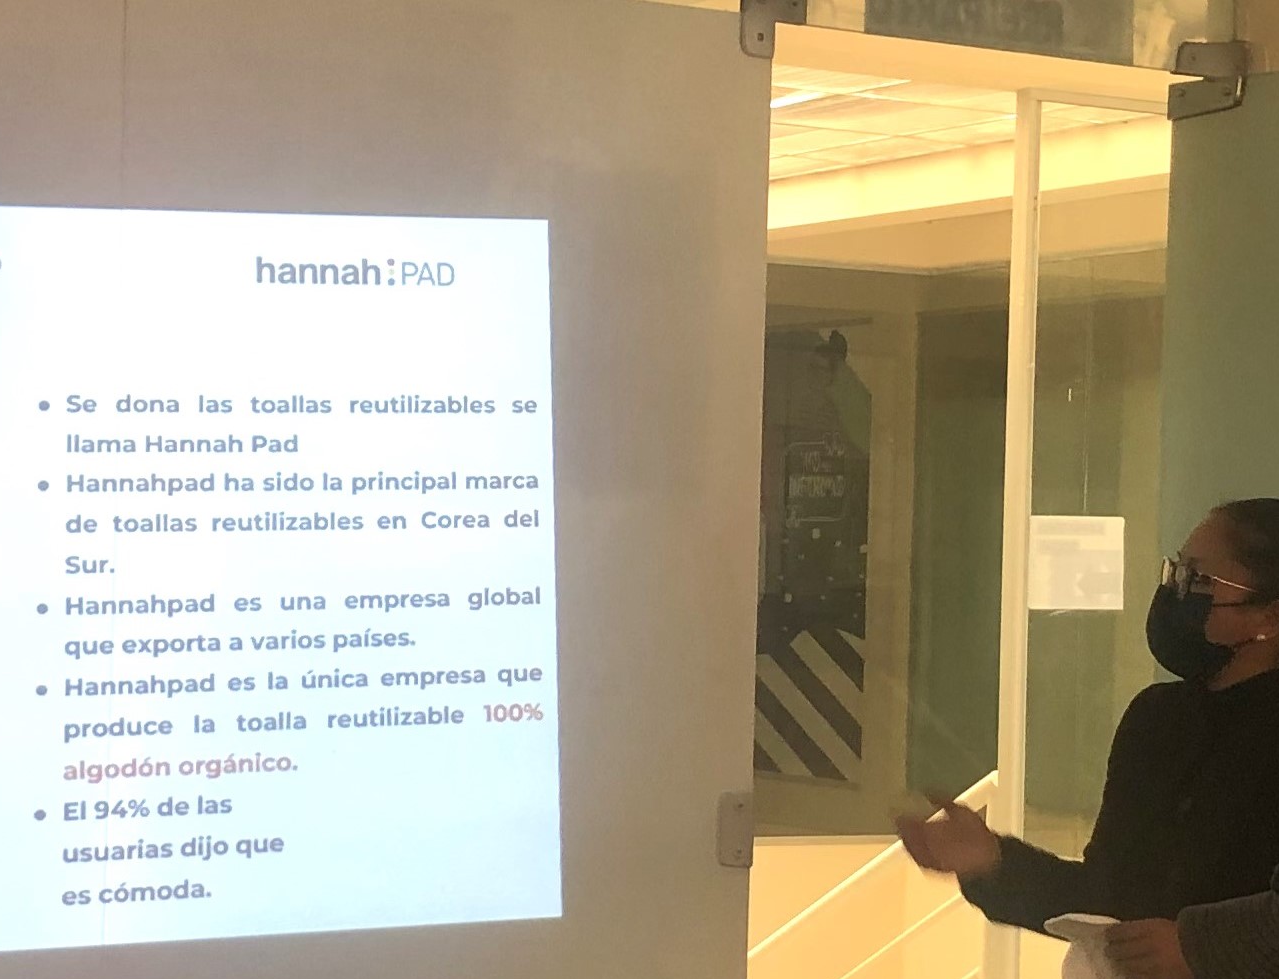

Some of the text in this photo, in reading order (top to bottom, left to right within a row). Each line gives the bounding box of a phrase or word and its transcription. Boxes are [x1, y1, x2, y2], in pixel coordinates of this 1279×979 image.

[66, 393, 538, 415] Se dona las toallas reutilizables se
[66, 433, 299, 454] llama Hannah Pad
[66, 470, 539, 497] Hannahpad ha sido la principal marca
[65, 508, 540, 534] de toallas reutilizables en Corea del
[64, 555, 115, 575] Sur.
[65, 585, 541, 618] Hannahpad es una empresa global
[64, 627, 416, 661] que exporta a varios países.
[64, 667, 543, 699] Hannahpad es la única empresa que
[63, 702, 546, 744] produce la toalla reutilizable 100%
[62, 751, 299, 785] algodón orgánico.
[63, 794, 233, 822] El 94% de las
[62, 834, 285, 864] usuarias dijo que
[61, 879, 212, 907] es cómoda.
